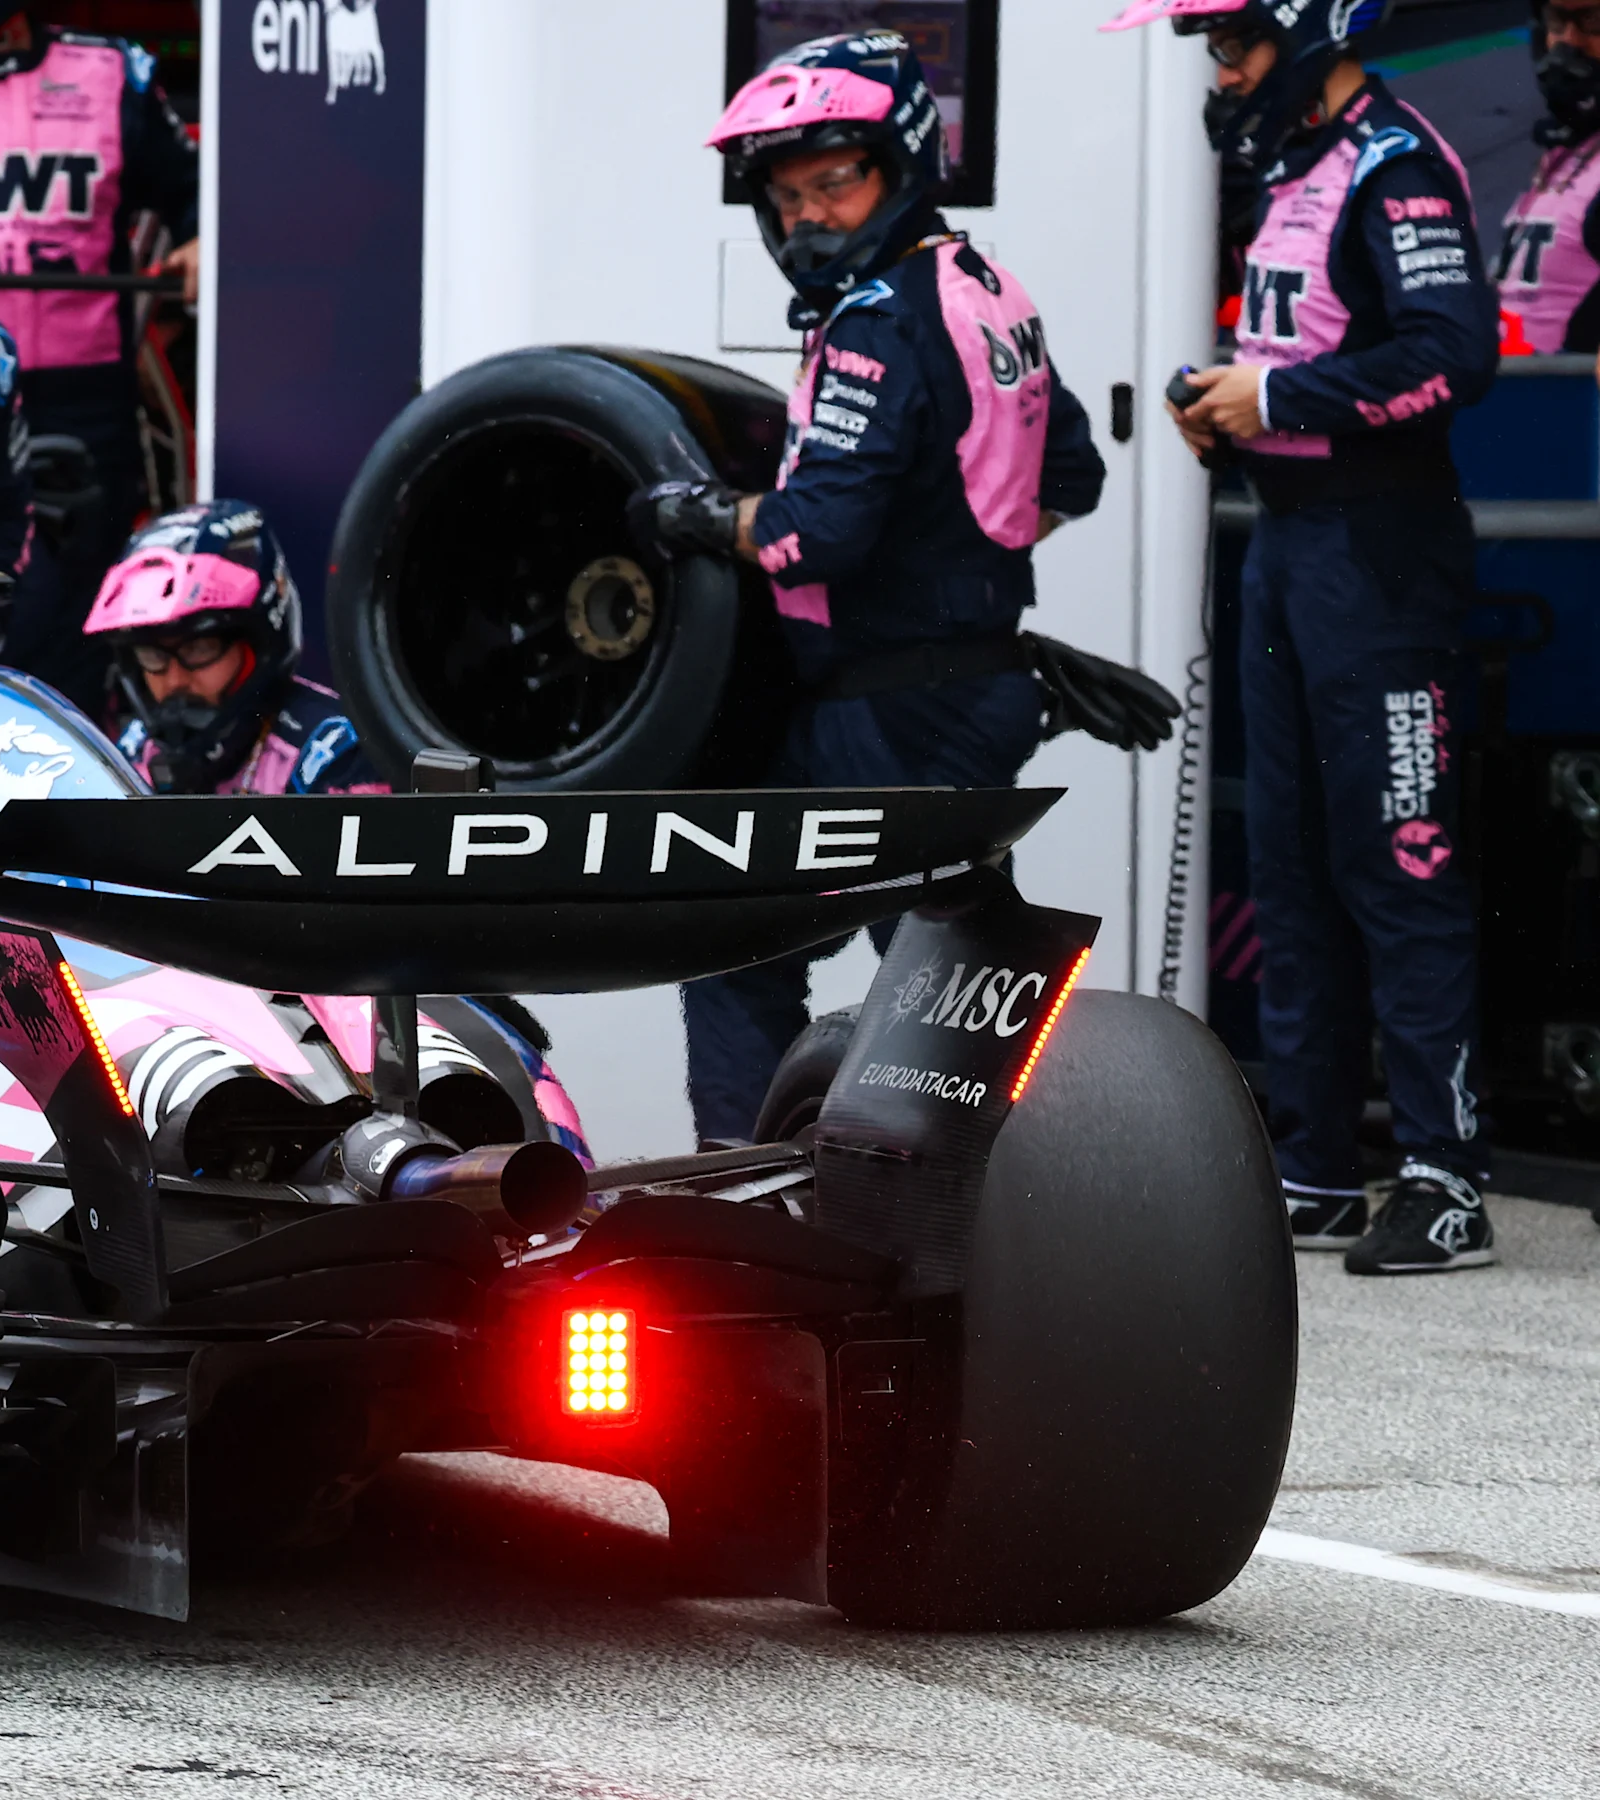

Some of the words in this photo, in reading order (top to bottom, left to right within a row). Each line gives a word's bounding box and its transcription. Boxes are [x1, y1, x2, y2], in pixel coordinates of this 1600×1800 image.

[252, 0, 320, 75] eni
[1385, 374, 1451, 421] BWT
[1384, 691, 1419, 820] CHANGE
[1413, 690, 1437, 794] WORLD
[187, 807, 884, 877] ALPINE
[920, 962, 1049, 1038] MSC
[858, 1062, 987, 1108] EURODATACAR
